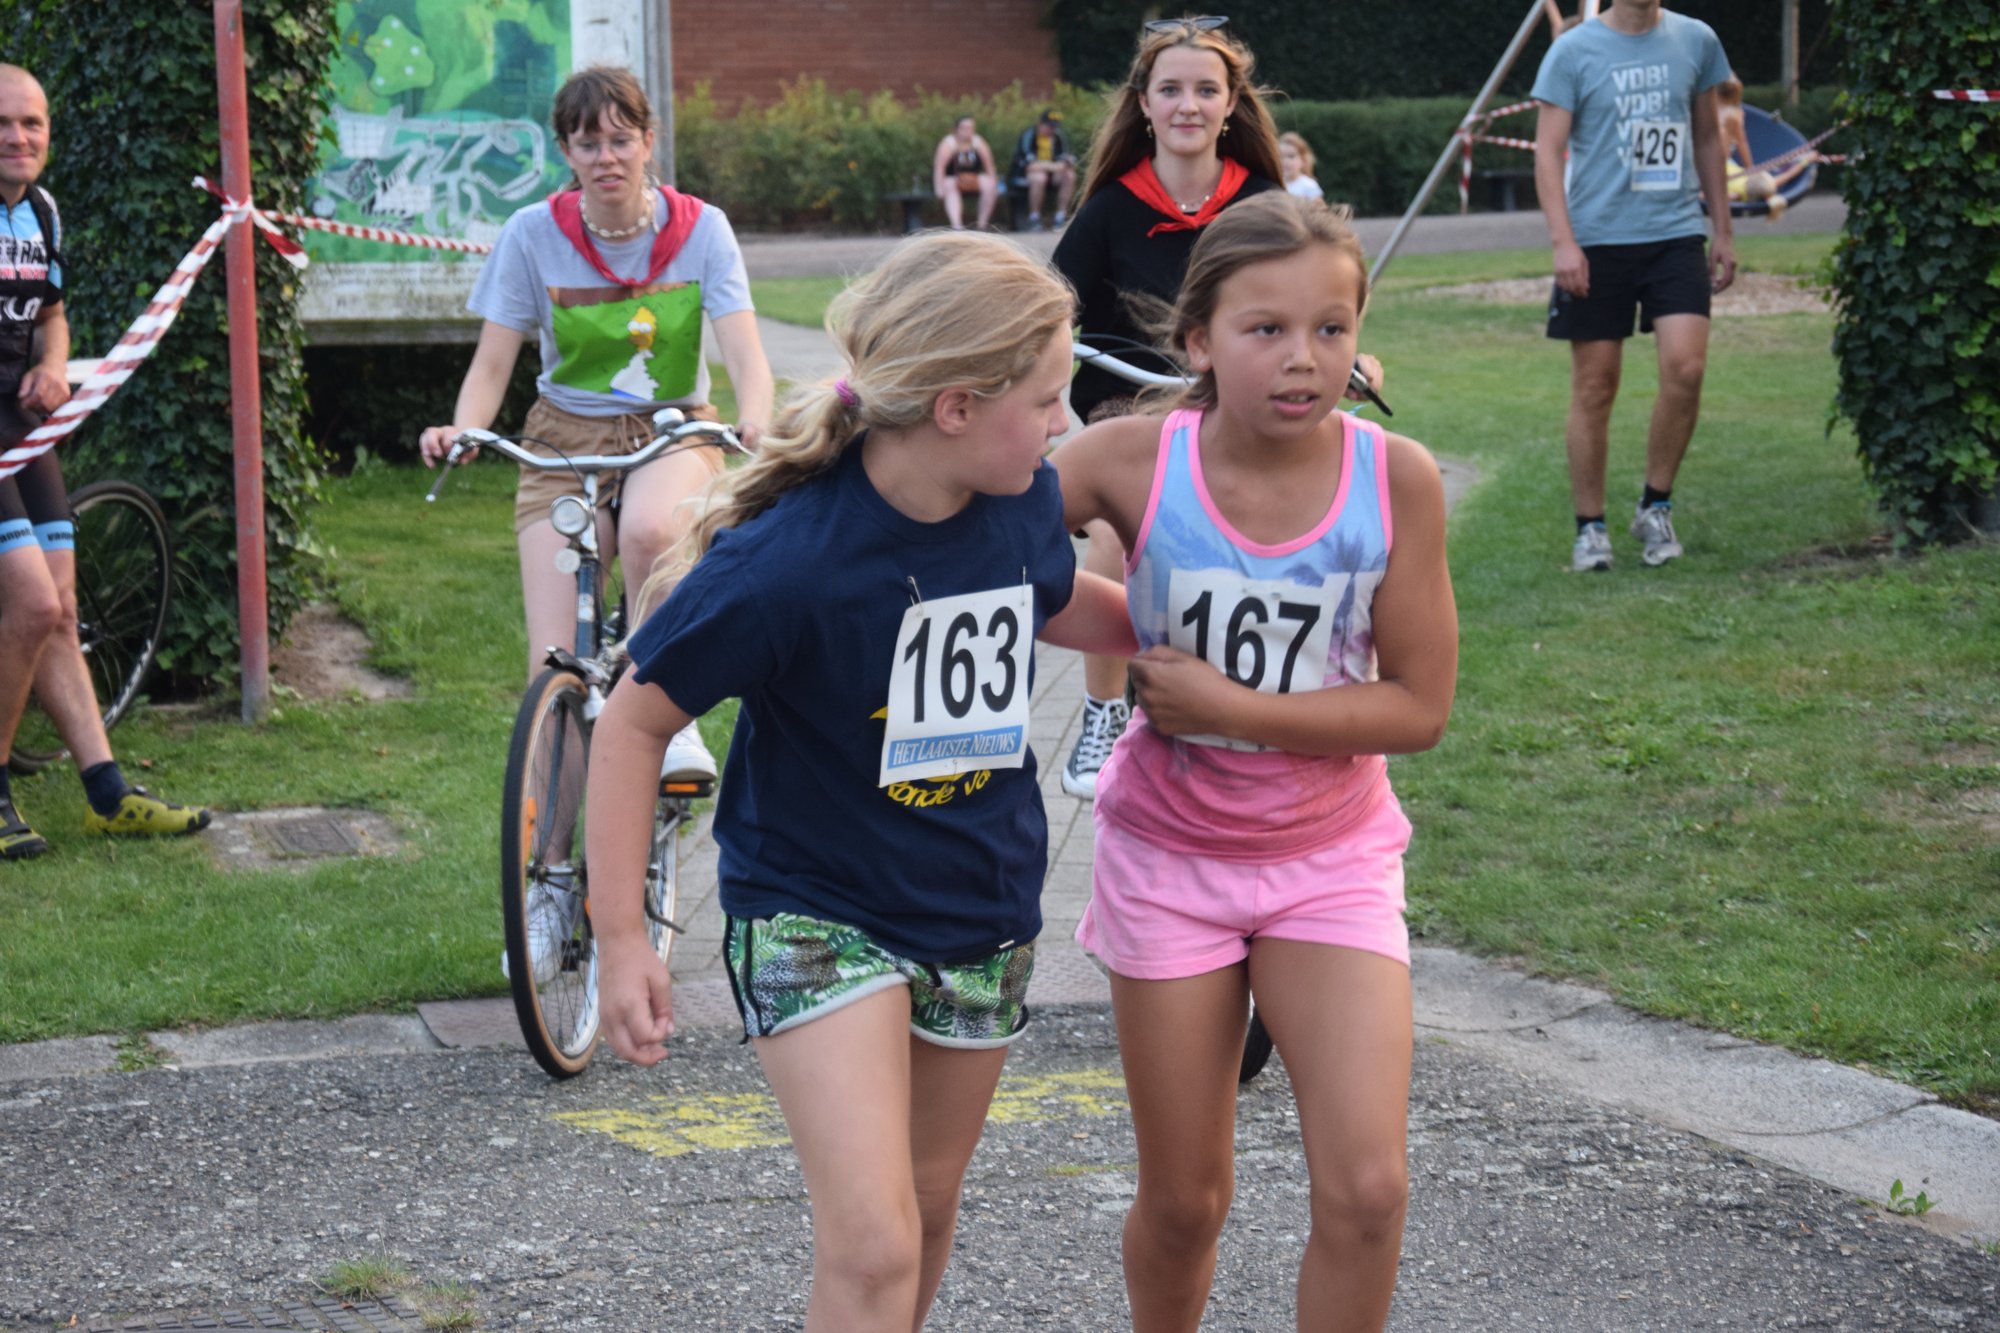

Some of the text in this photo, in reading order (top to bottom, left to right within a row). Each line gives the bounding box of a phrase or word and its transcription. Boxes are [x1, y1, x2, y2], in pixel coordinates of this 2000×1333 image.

[1612, 64, 1669, 92] VDB!
[1615, 90, 1671, 117] VDB!
[1633, 127, 1678, 166] 426
[1182, 590, 1321, 694] 167
[903, 606, 1019, 723] 163
[893, 732, 1017, 766] HET LAATSTE NIEUWS
